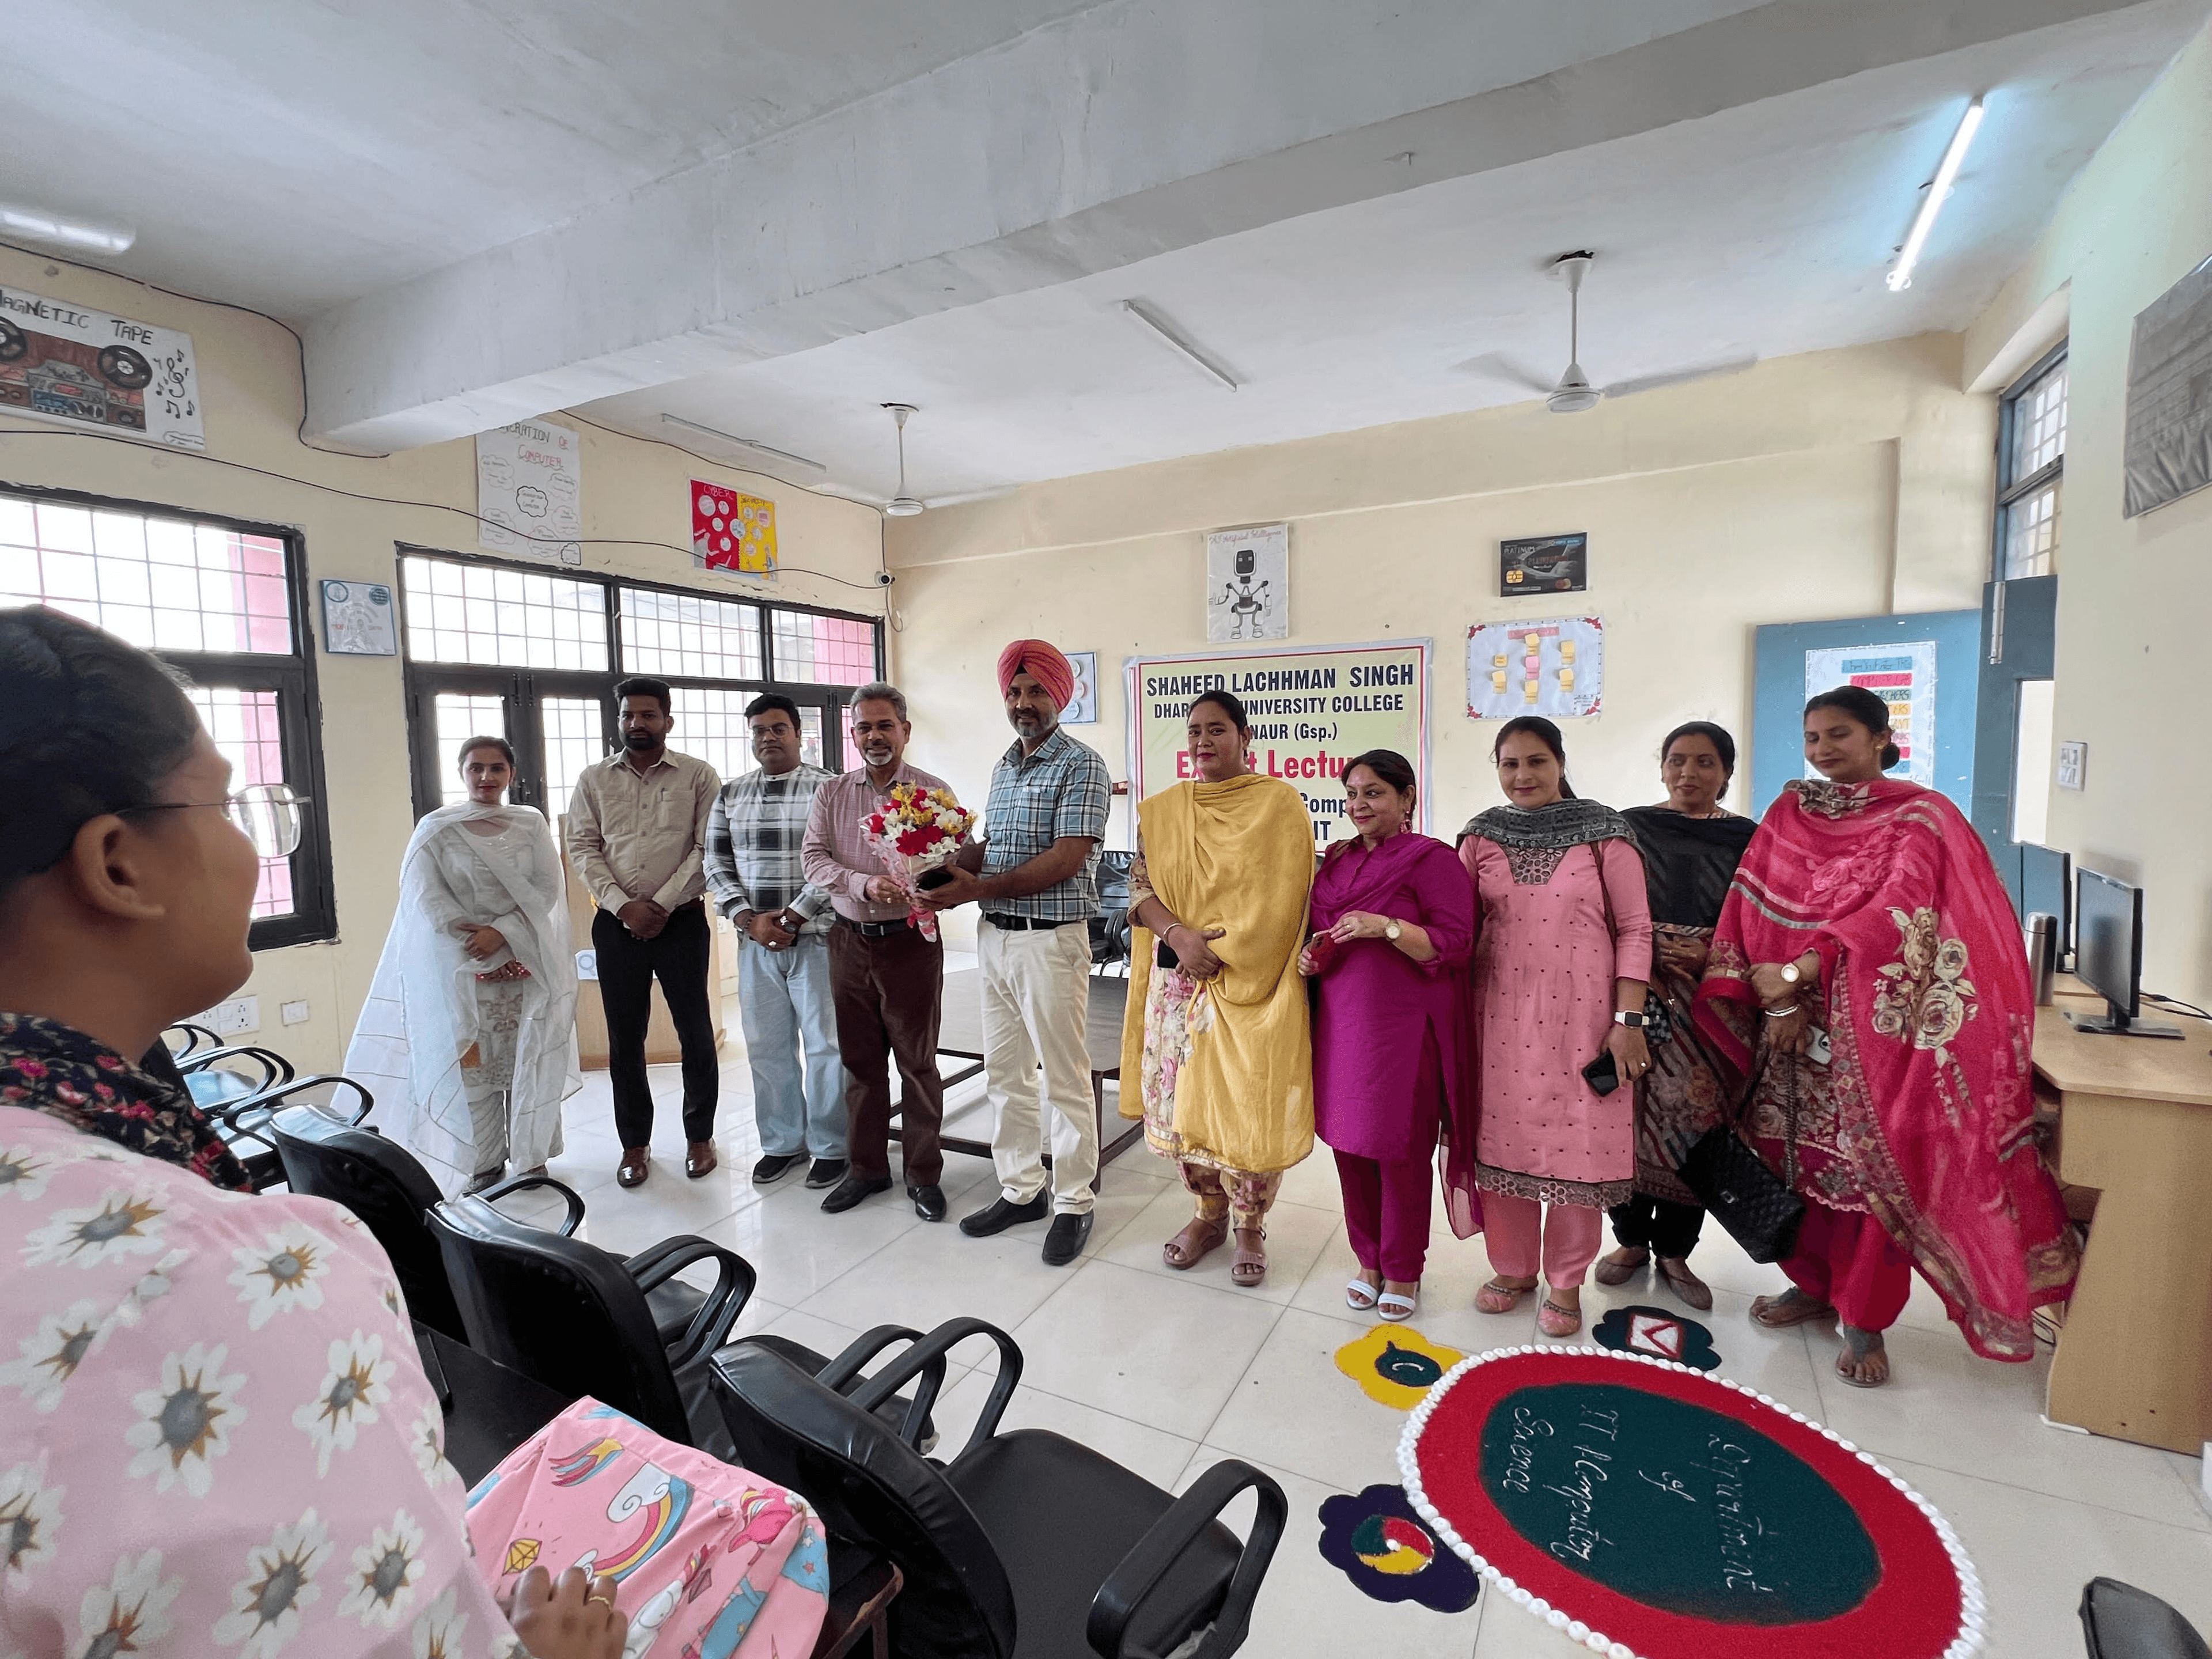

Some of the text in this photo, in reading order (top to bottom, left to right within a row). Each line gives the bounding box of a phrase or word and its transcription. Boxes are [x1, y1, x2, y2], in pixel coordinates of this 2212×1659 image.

[0, 289, 154, 345] AGNETIC TAPE
[1146, 664, 1413, 696] SHAHEED LACHHMAN SINGH
[1154, 694, 1404, 718] DHAR UNIVERSITY COLLEGE
[1249, 722, 1338, 742] NAUR (Gsp.)
[1268, 749, 1353, 778] Lectu
[1579, 1404, 1619, 1441] IT
[1502, 1407, 1554, 1493] Science
[1638, 1469, 1696, 1502] of
